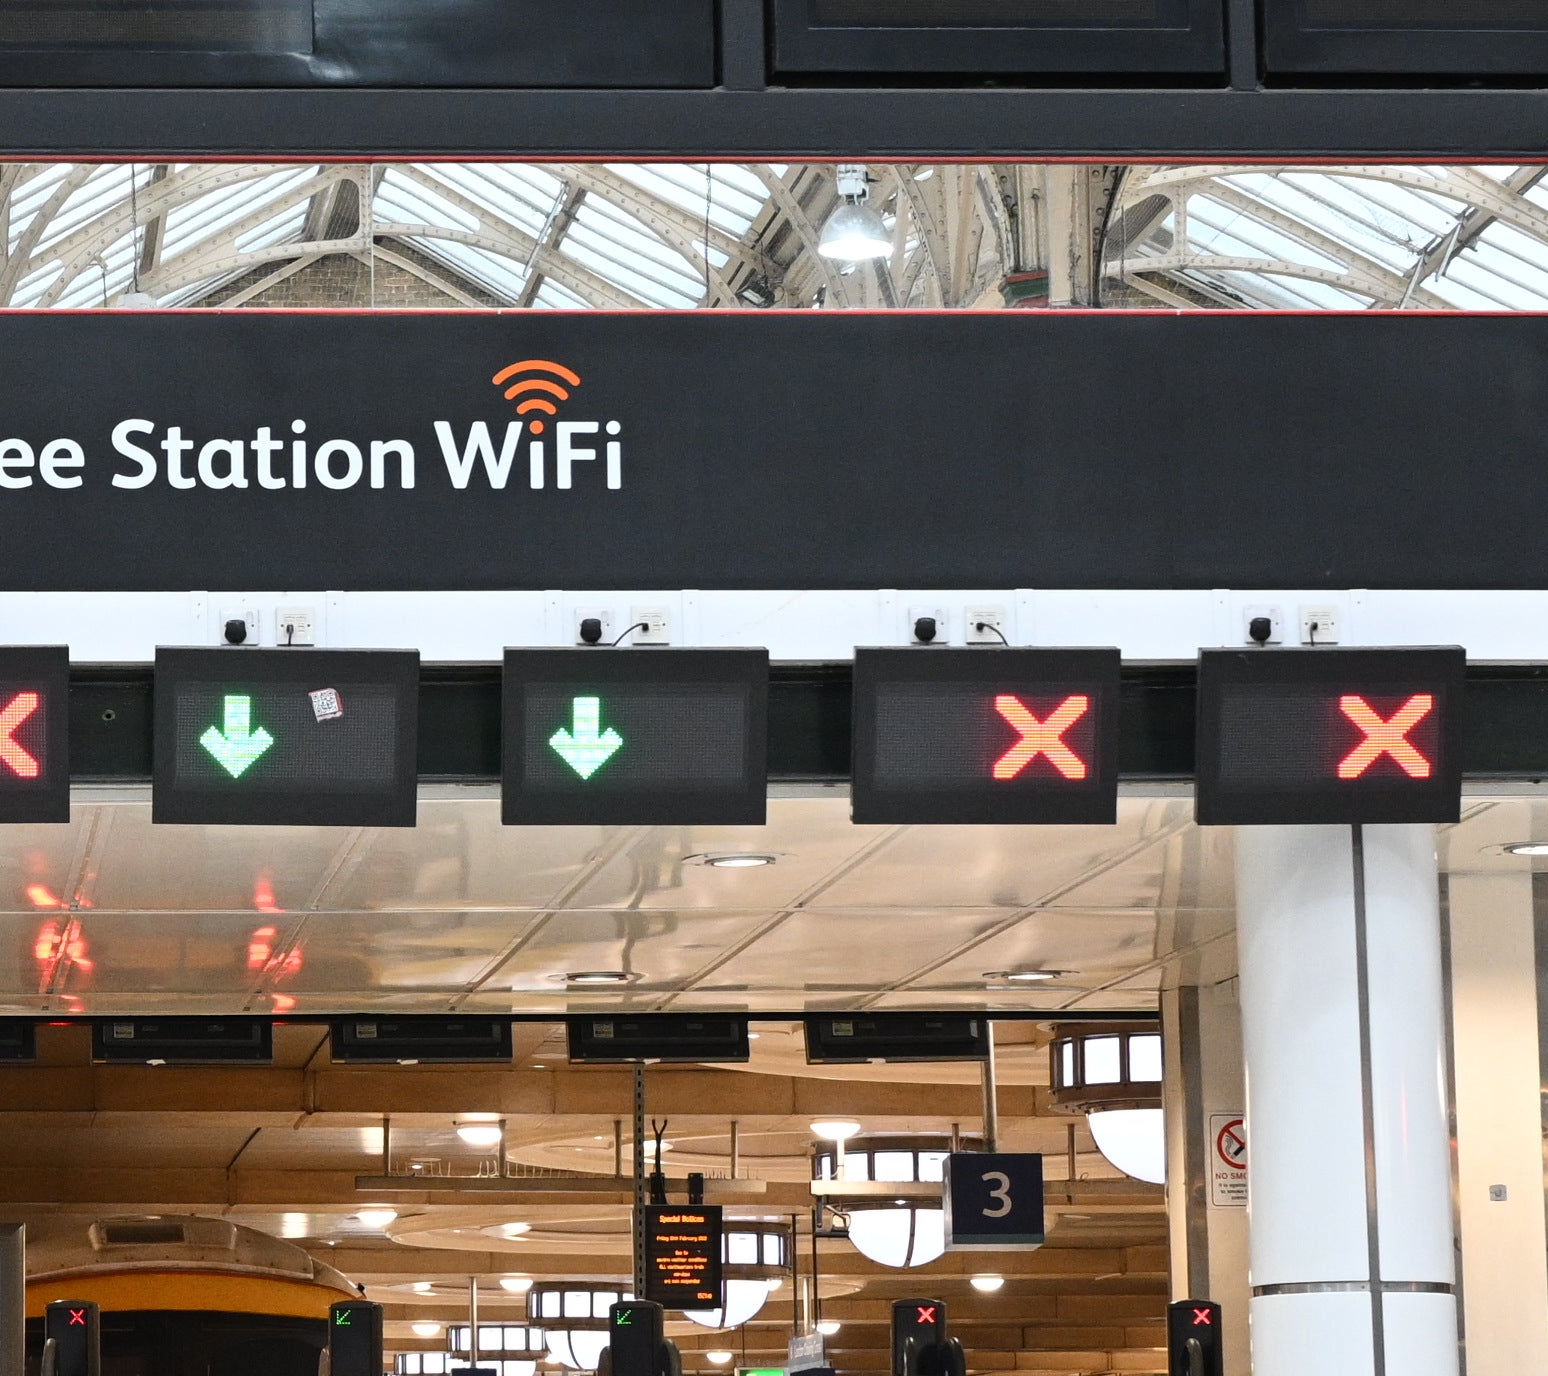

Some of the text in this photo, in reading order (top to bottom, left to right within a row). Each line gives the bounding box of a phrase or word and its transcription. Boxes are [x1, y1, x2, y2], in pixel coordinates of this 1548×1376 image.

[111, 418, 415, 490] Station
[434, 419, 624, 491] WiFi
[981, 1172, 1013, 1219] 3
